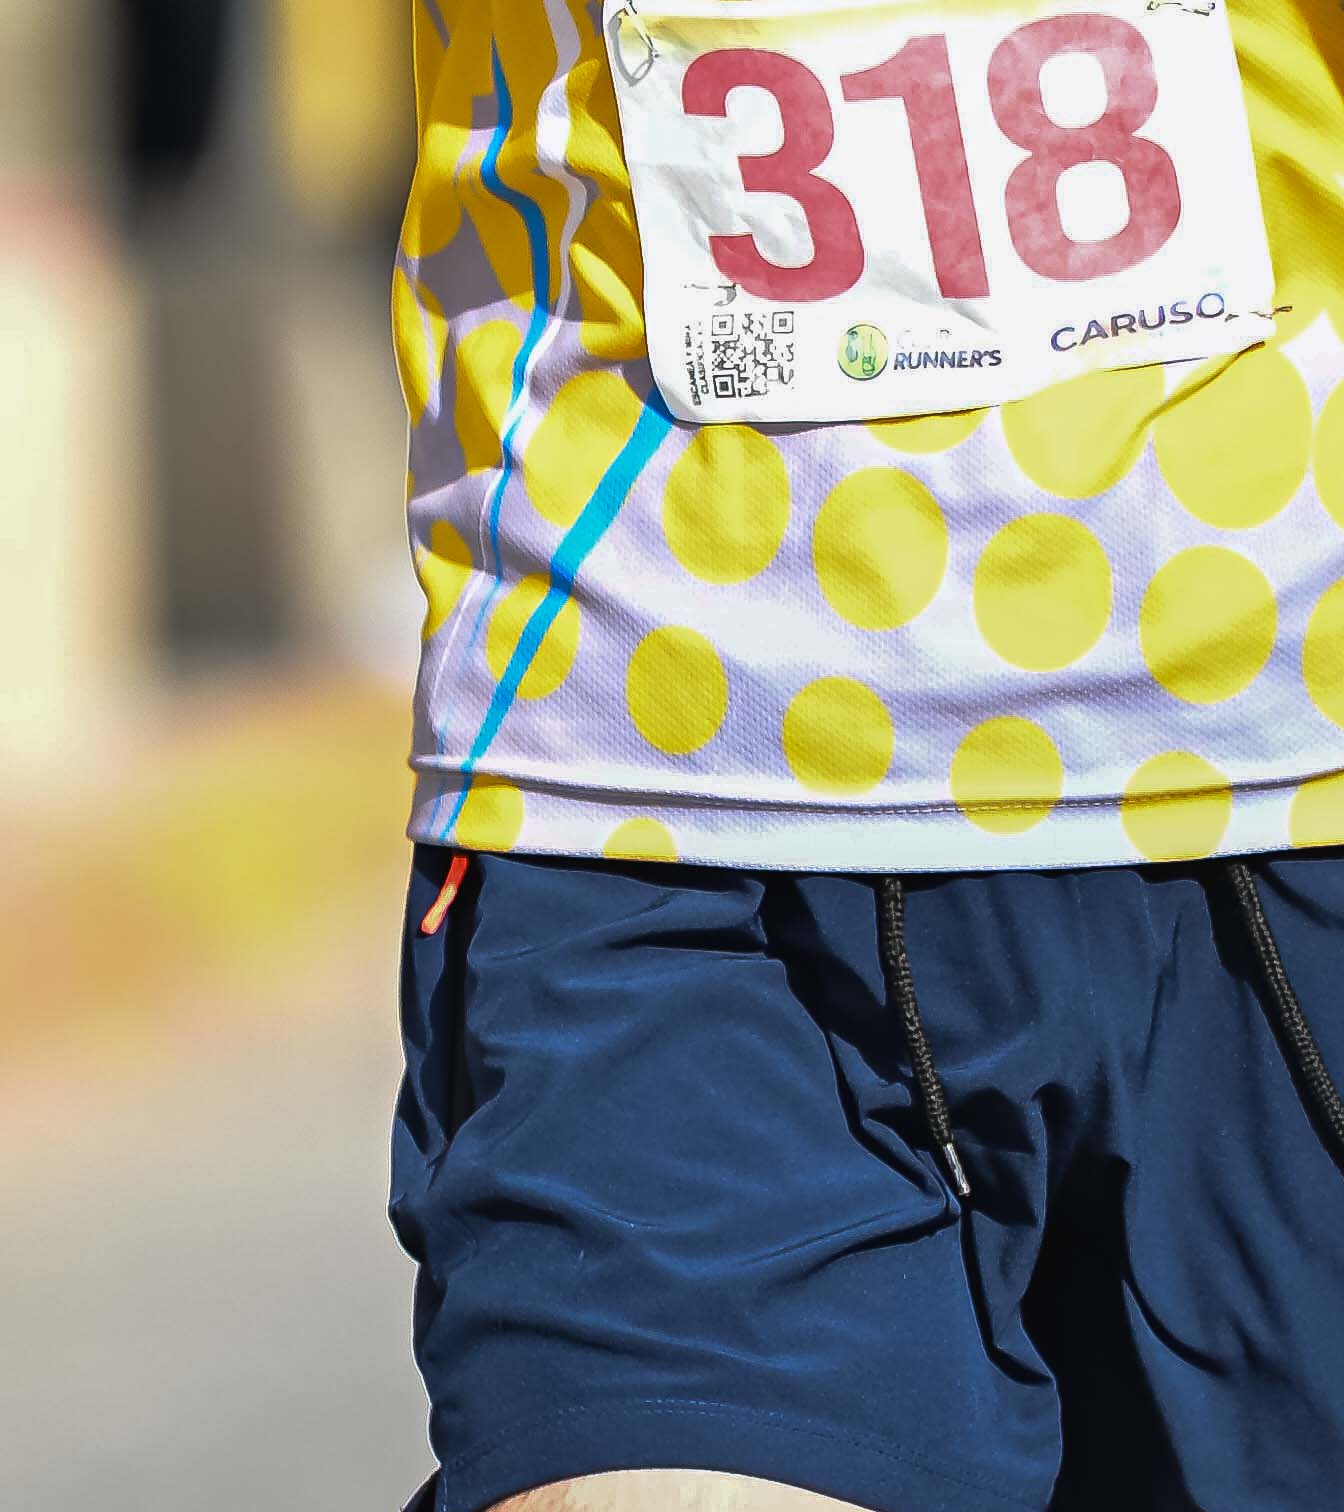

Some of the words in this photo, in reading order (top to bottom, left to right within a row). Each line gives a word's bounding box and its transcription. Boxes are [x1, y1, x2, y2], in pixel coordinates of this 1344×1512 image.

[682, 12, 1182, 303] 318
[1050, 292, 1226, 352] CARUSO
[893, 349, 1003, 371] RUNNER'S
